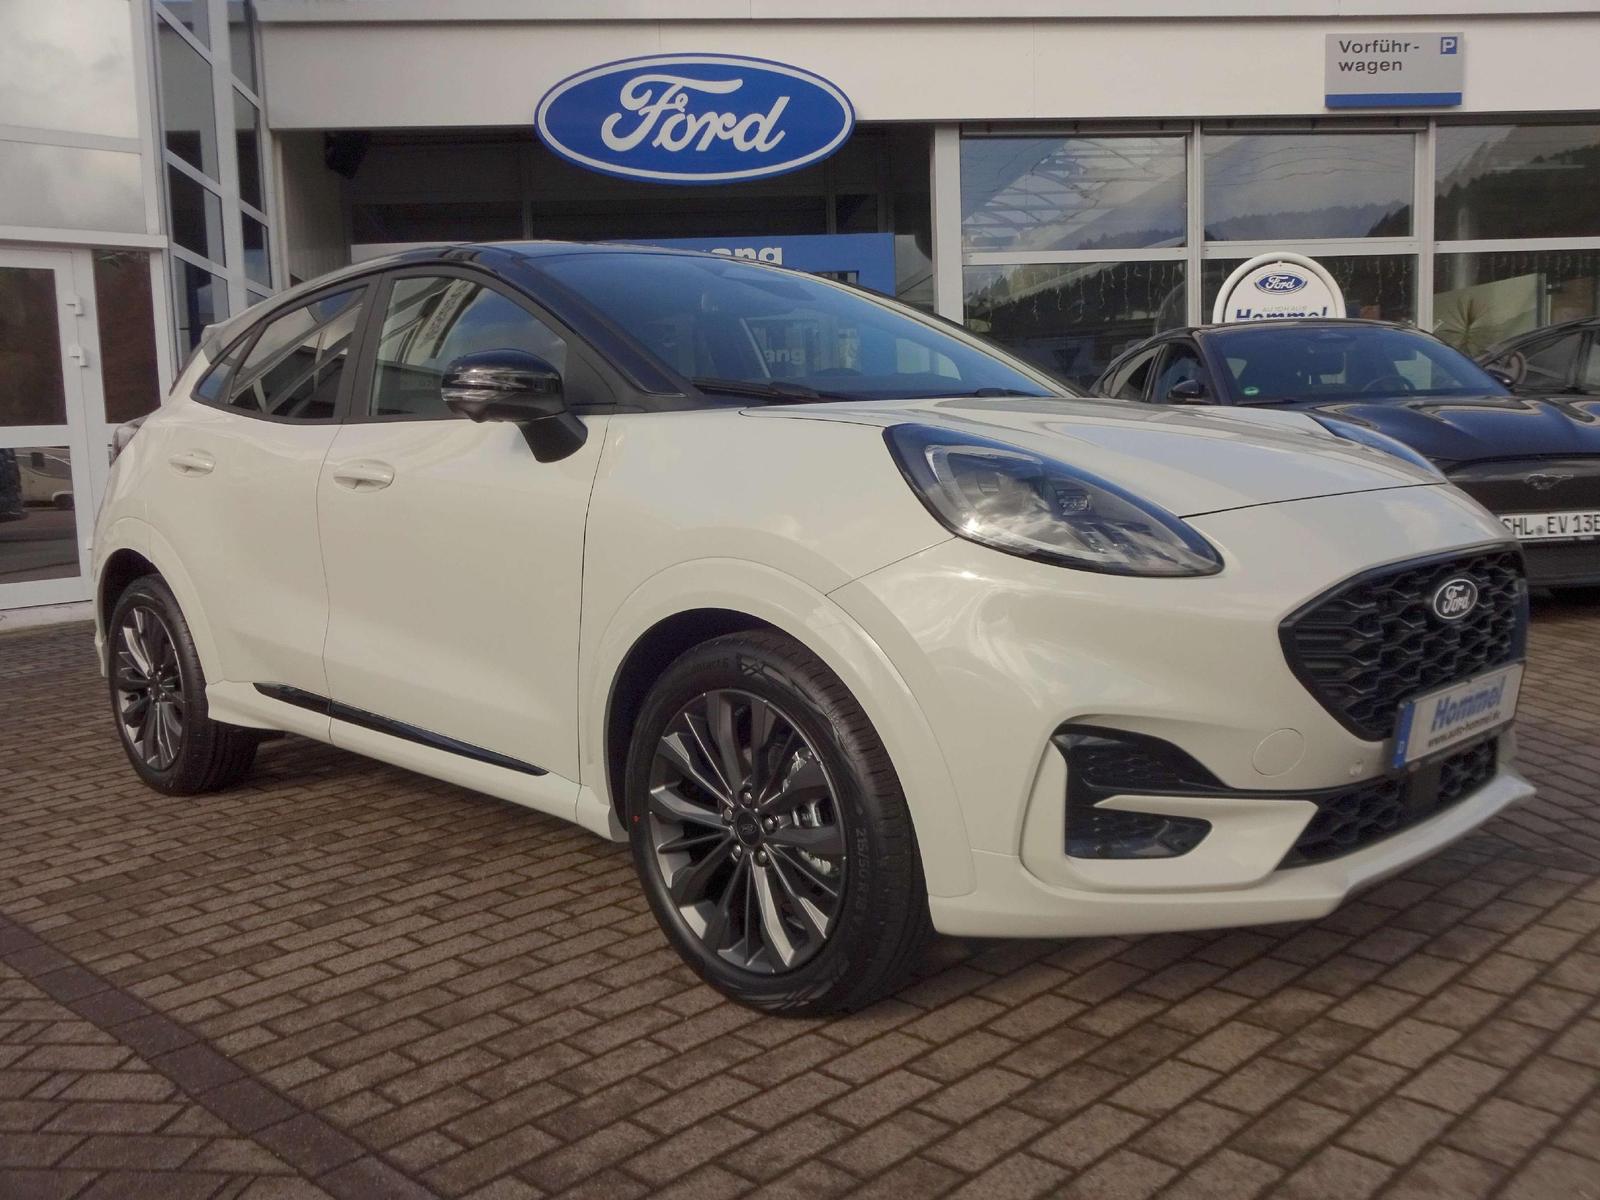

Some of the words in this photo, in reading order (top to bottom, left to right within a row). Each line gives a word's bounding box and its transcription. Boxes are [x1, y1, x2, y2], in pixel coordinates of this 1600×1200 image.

[1338, 40, 1420, 54] Vorführ-
[1442, 39, 1456, 53] P
[1338, 60, 1403, 75] wagen
[601, 73, 791, 153] Ford
[1265, 276, 1297, 289] Ford
[1547, 516, 1568, 534] EV
[1442, 585, 1471, 613] Ford
[1431, 675, 1507, 733] Hommel
